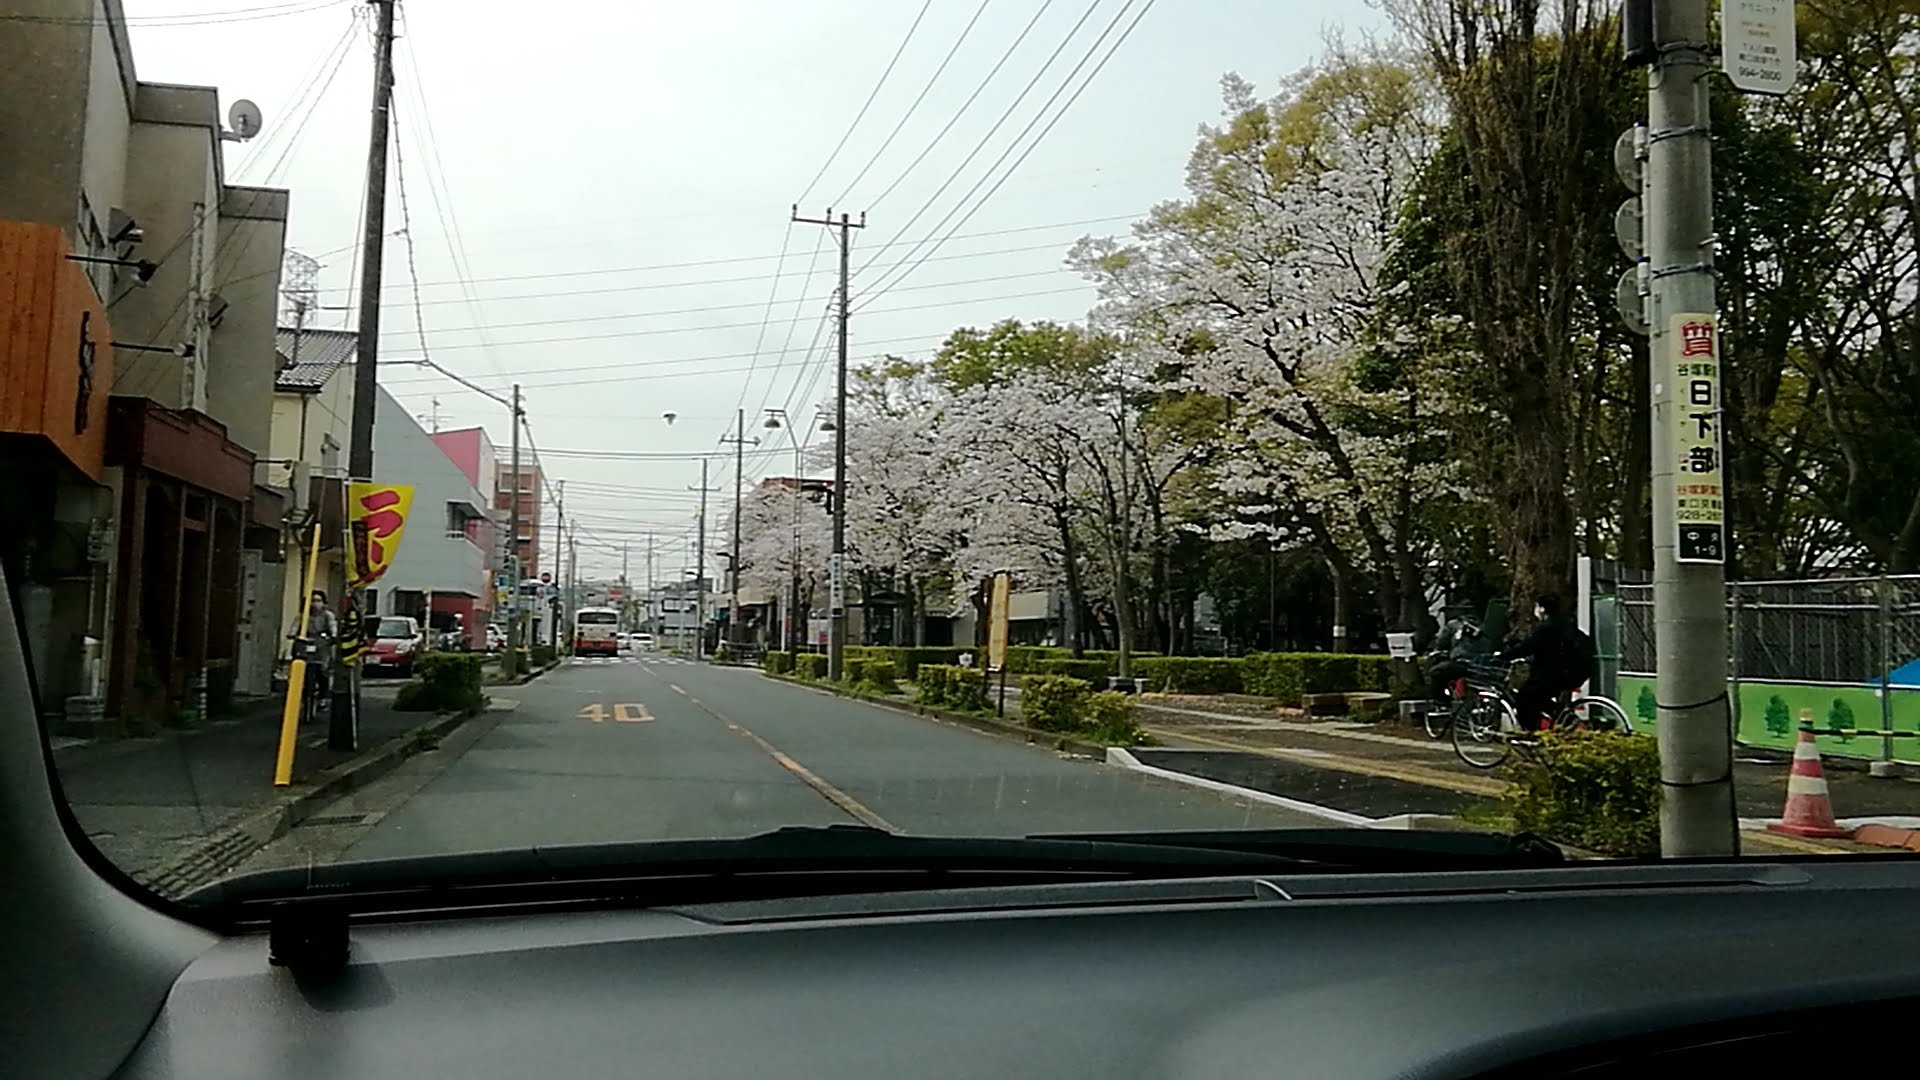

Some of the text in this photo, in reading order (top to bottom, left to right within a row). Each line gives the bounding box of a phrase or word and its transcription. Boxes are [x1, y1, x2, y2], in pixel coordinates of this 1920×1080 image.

[1680, 321, 1715, 358] 質
[1689, 380, 1714, 474] 日下部
[576, 703, 655, 722] 40
